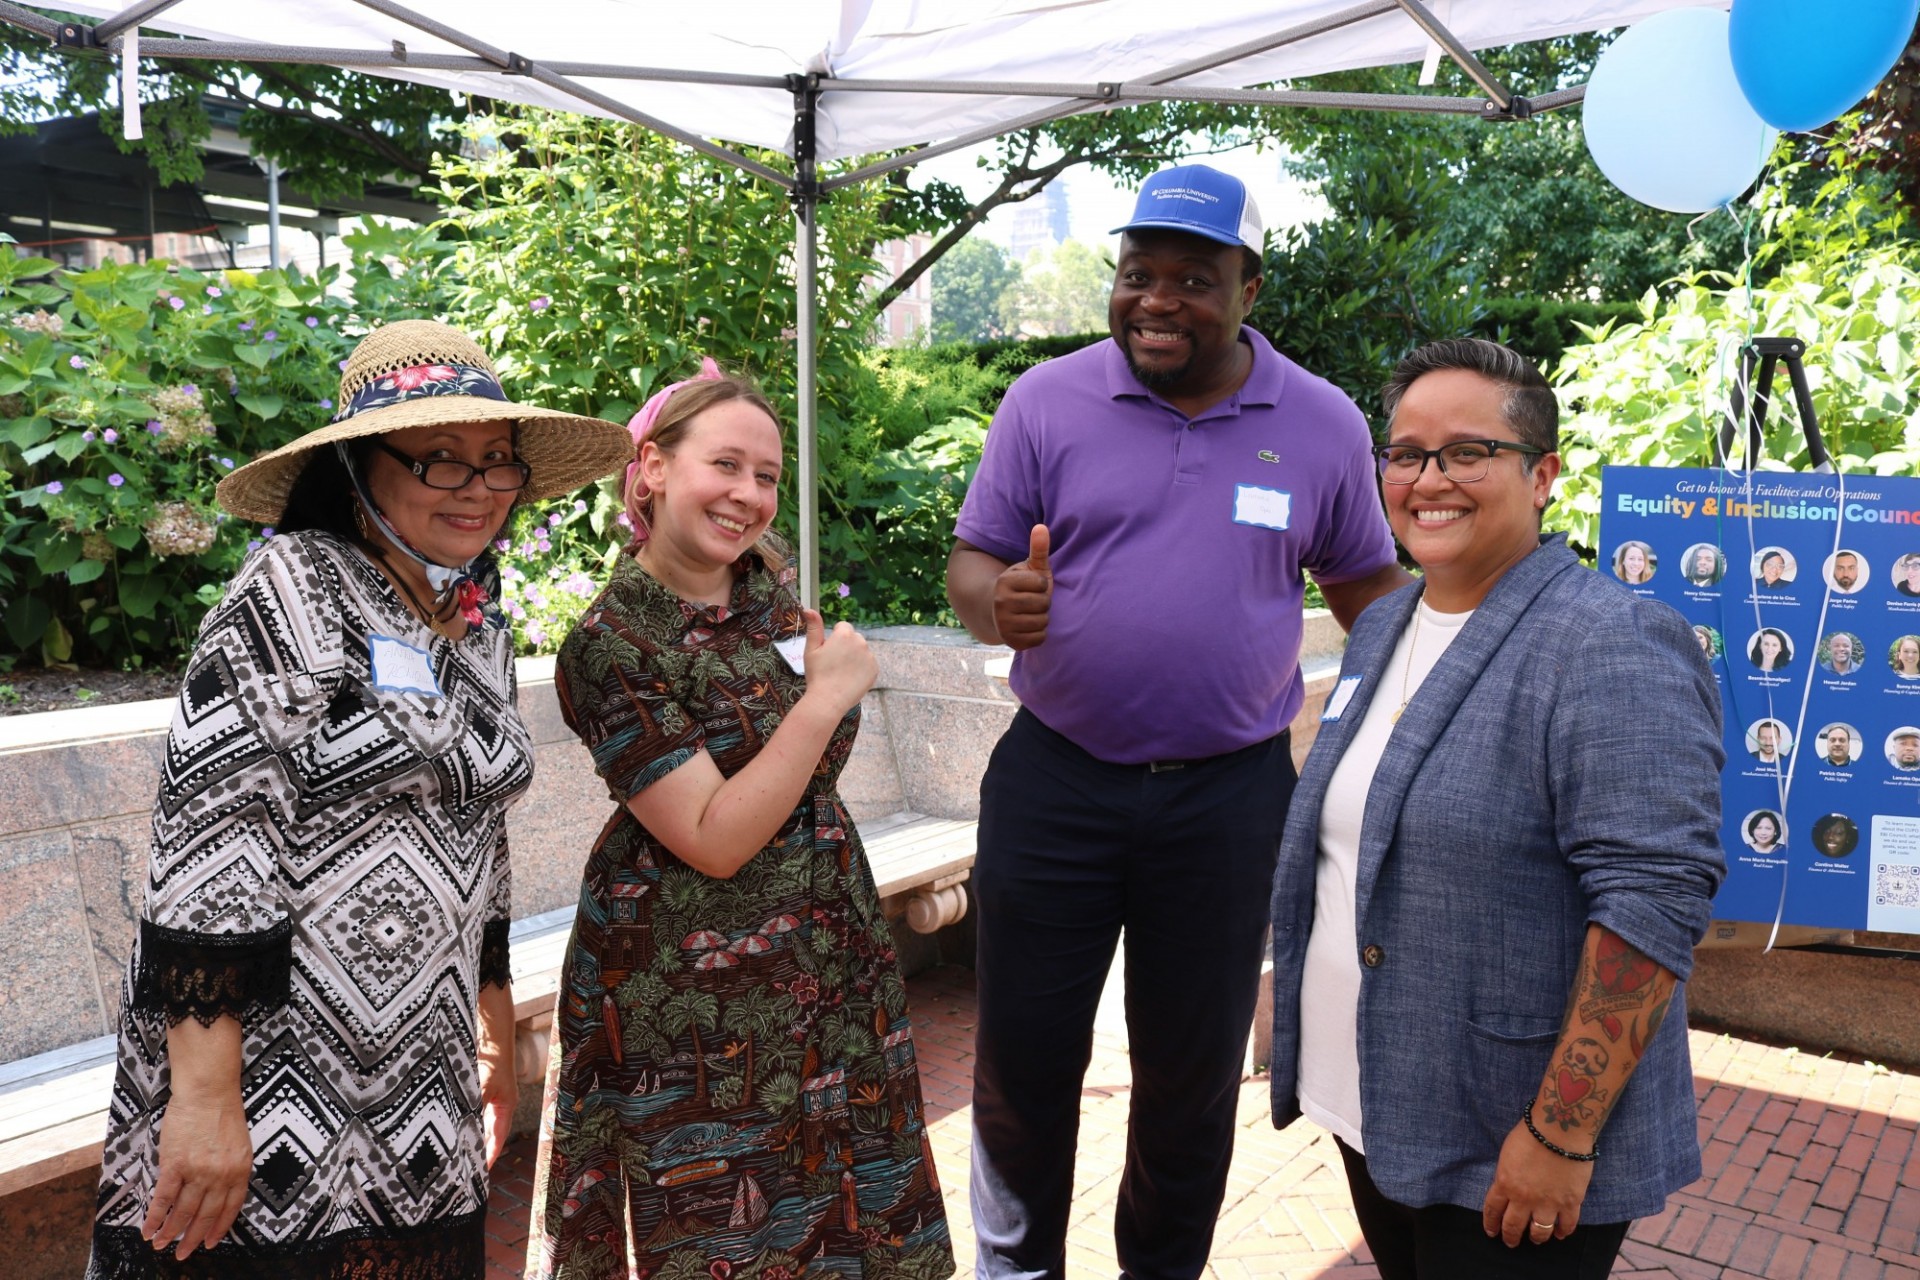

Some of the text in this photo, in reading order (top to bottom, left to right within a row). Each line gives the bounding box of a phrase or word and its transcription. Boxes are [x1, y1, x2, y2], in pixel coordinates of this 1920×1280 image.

[1186, 187, 1220, 203] UNIVERSITY
[1676, 480, 1696, 493] Get
[1696, 482, 1706, 493] to
[1708, 481, 1736, 495] know
[1755, 483, 1800, 498] Facilities
[1801, 485, 1823, 499] and
[1617, 493, 1697, 519] Equity
[1701, 496, 1719, 517] &
[1725, 497, 1838, 522] Inclusion
